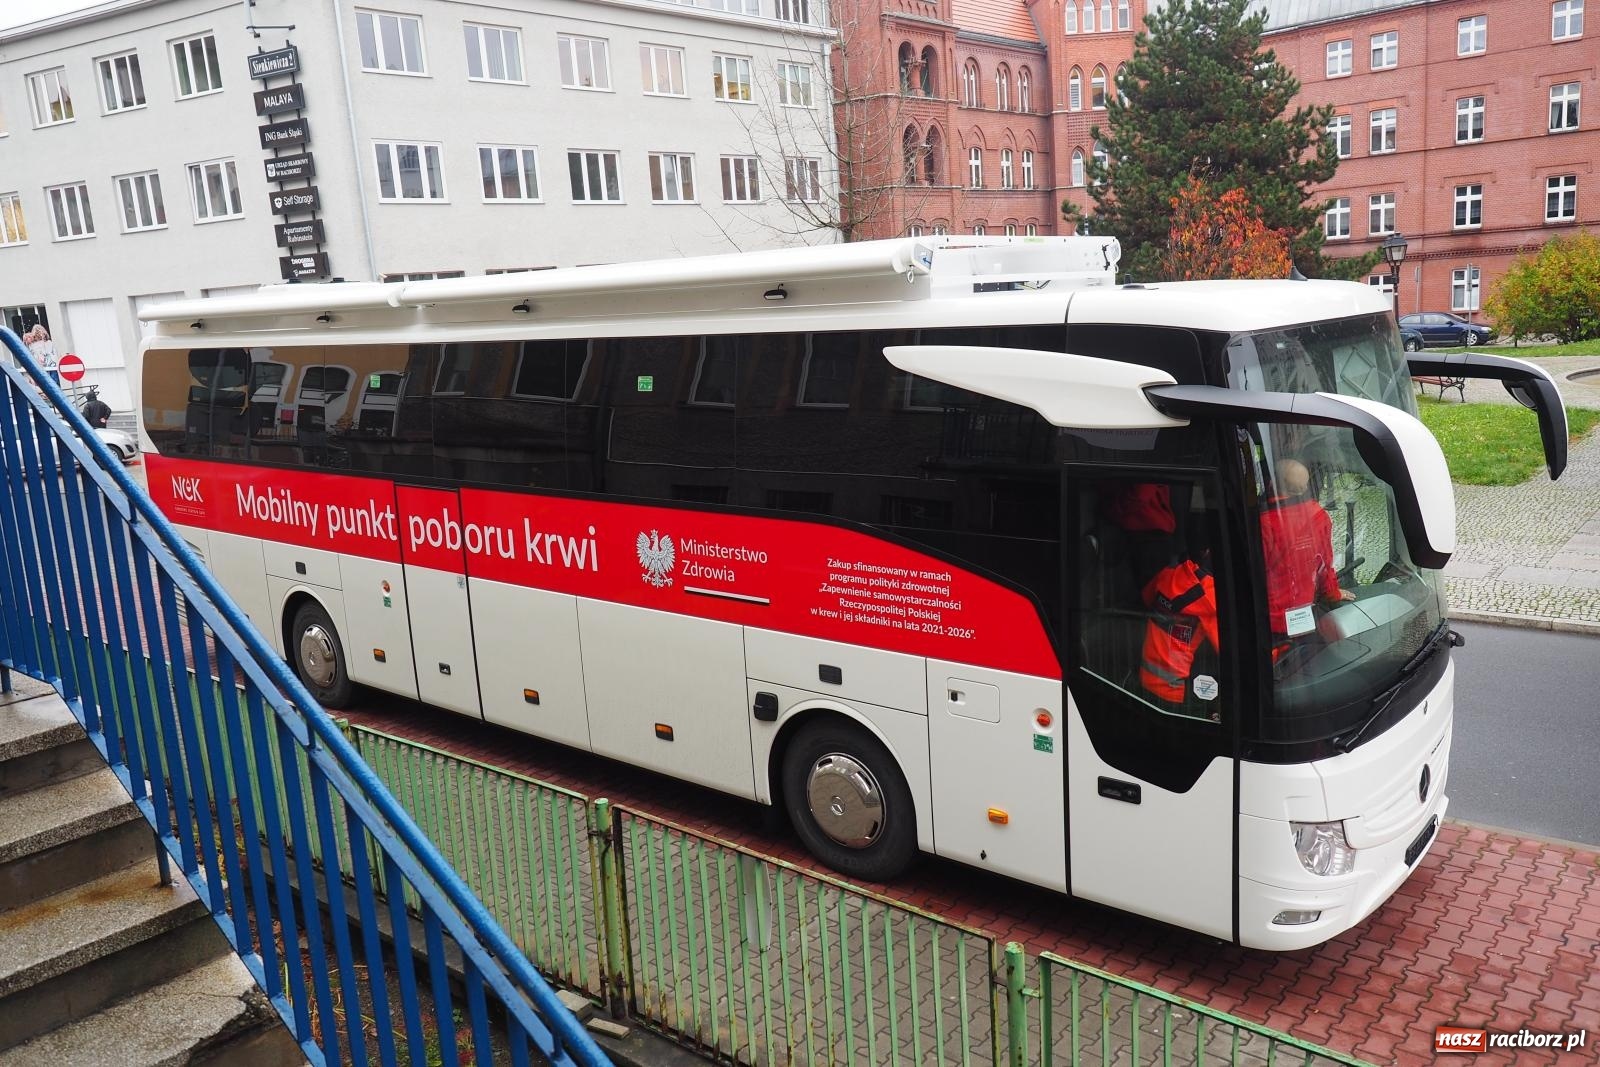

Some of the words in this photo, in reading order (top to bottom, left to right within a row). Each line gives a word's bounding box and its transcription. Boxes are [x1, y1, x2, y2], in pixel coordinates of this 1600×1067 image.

[252, 56, 289, 74] Sienkiewicza
[264, 93, 293, 108] MALAYA
[264, 131, 277, 141] ING
[276, 130, 288, 140] Bank
[283, 195, 295, 206] Self
[293, 194, 314, 205] Storage
[235, 483, 319, 537] Mobilny
[326, 499, 398, 541] punkt
[408, 507, 516, 560] poboru
[523, 517, 599, 572] krwi
[680, 537, 768, 563] Ministerstwo
[681, 559, 735, 582] Zdrowia
[827, 557, 852, 571] Zakup
[853, 561, 909, 578] sfinansowany
[909, 569, 918, 578] w
[919, 571, 952, 582] ramach
[829, 573, 868, 584] programu
[869, 577, 900, 590] polityki
[901, 581, 950, 597] zdrowotnej
[839, 597, 906, 618] Rzeczypospolitej
[908, 607, 941, 623] Polskiej
[873, 590, 962, 611] samowystarczalności
[810, 607, 818, 616] w
[818, 606, 838, 619] krew
[843, 610, 854, 623] jej
[854, 612, 891, 627] składniki
[892, 619, 903, 629] na
[904, 619, 920, 632] lata
